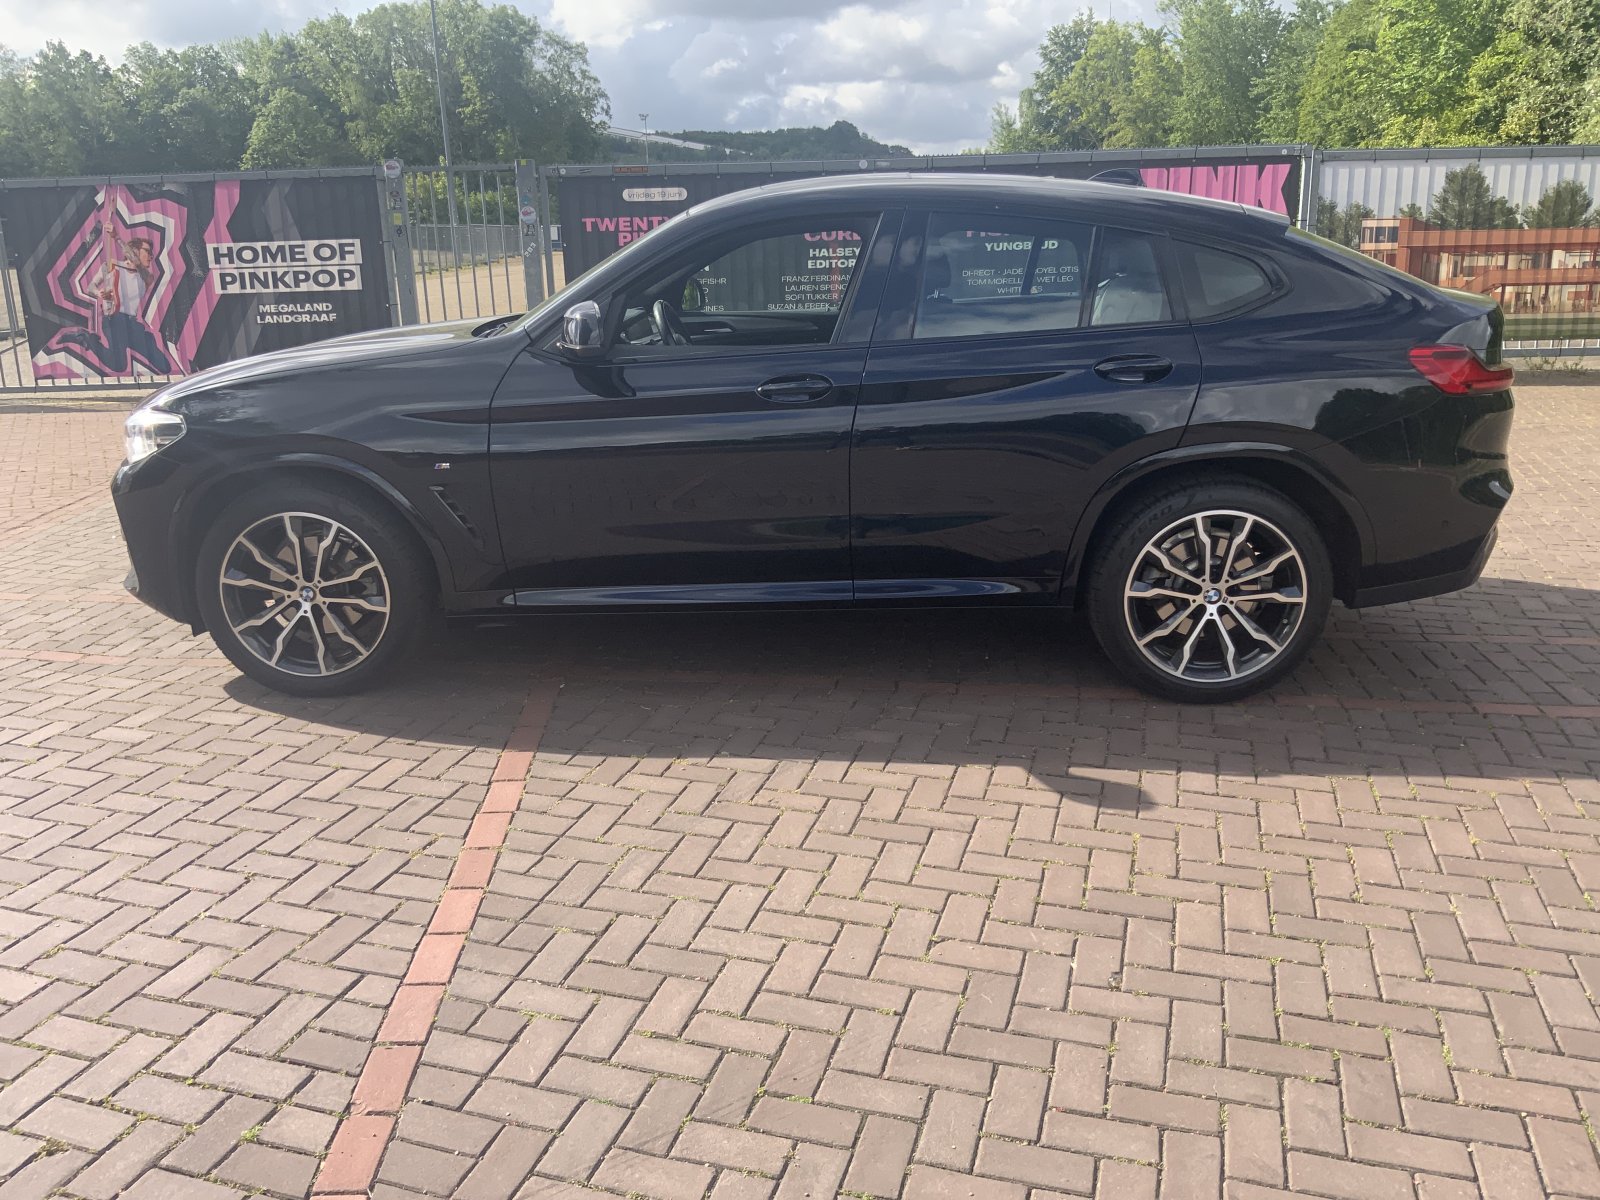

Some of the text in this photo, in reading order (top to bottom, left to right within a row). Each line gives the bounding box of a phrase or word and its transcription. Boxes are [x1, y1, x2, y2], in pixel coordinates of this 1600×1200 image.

[627, 191, 656, 200] vrijdag
[667, 191, 683, 199] juni
[582, 216, 671, 232] TWENT
[213, 242, 356, 265] HOME OF
[807, 259, 857, 269] EDITOR
[1003, 268, 1024, 276] JADE
[1035, 266, 1058, 274] OYEL
[1059, 265, 1079, 273] OTIS
[219, 269, 356, 291] PINKPOP
[781, 275, 810, 283] FRANZ
[967, 278, 987, 286] TOM
[1057, 275, 1074, 283] LEG
[785, 284, 819, 292] LAUREN
[785, 293, 805, 301] SOFI
[259, 302, 333, 313] MEGALAND
[805, 302, 830, 310] FREEK
[256, 313, 337, 324] LANDGRAAF
